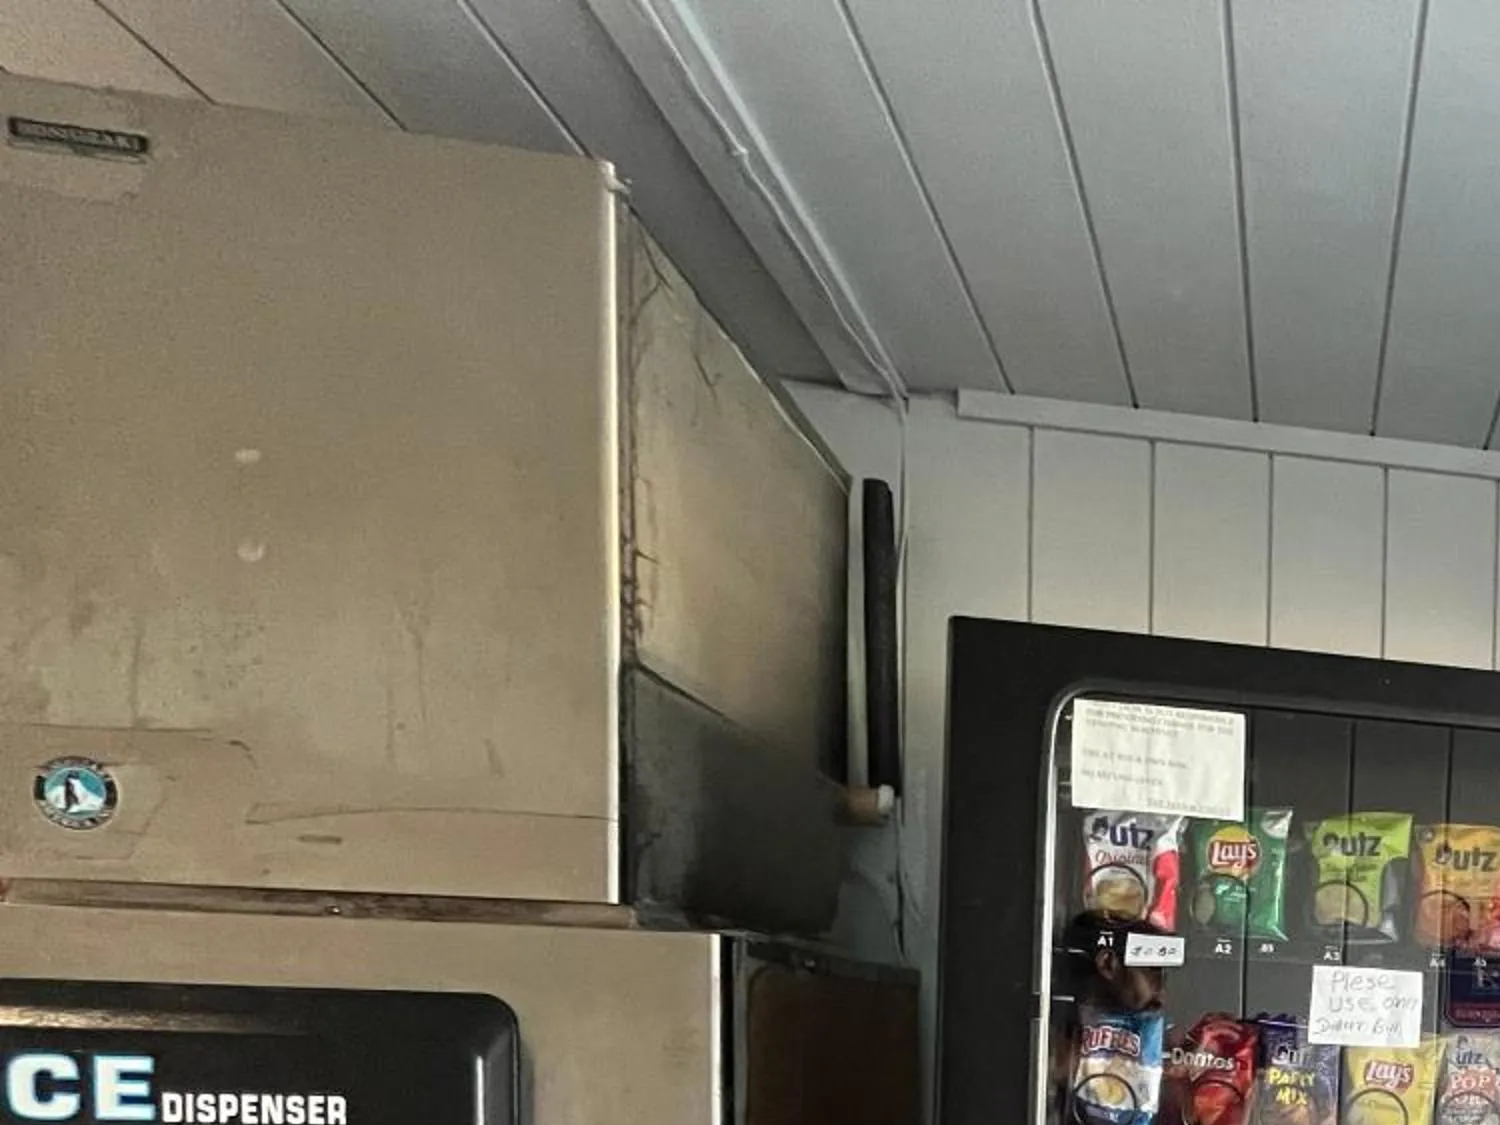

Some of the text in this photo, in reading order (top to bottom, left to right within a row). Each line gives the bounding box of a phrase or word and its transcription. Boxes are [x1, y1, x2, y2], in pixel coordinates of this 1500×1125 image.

[1097, 936, 1114, 947] A1
[1215, 942, 1232, 954] A2
[1170, 1047, 1235, 1070] Doritos
[1364, 1059, 1412, 1087] Lay's
[1275, 1085, 1309, 1105] MIX
[161, 1091, 348, 1125] DISPENSER
